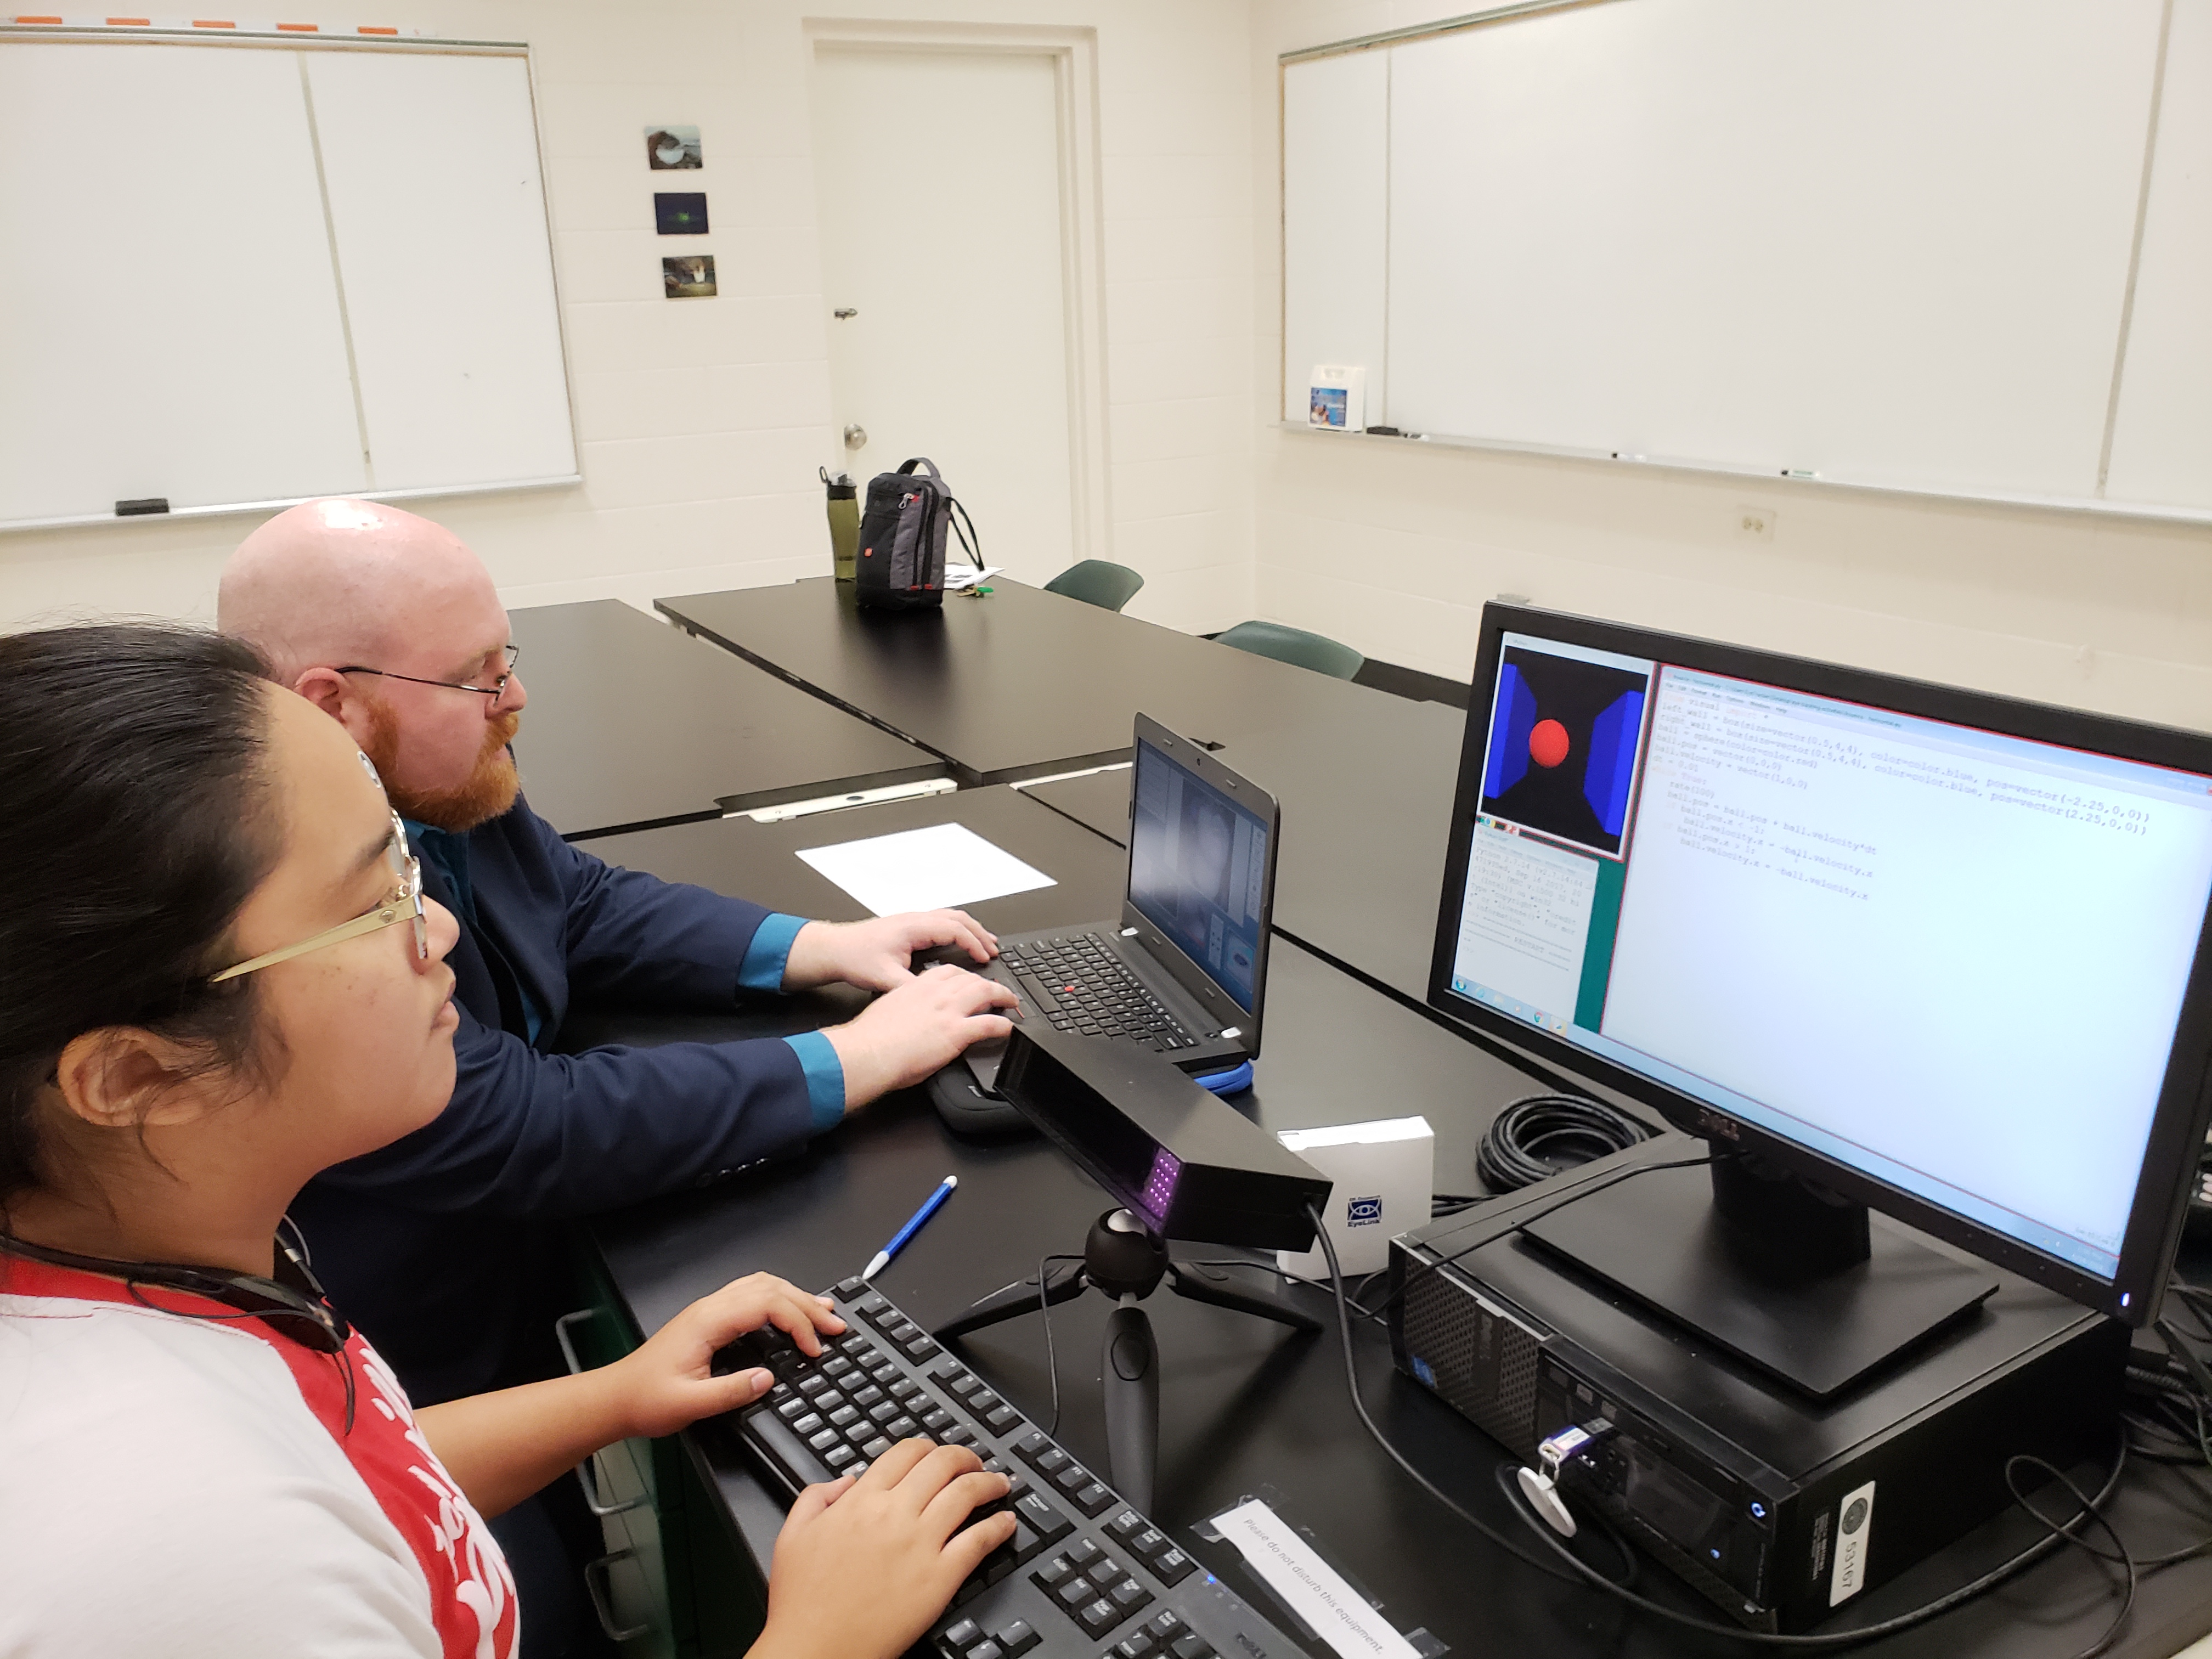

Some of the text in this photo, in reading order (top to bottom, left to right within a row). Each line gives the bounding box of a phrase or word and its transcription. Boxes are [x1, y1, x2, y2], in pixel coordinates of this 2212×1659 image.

[1243, 1518, 1385, 1656] Please do not disturb this equipment.
[1841, 1540, 1858, 1588] 53167
